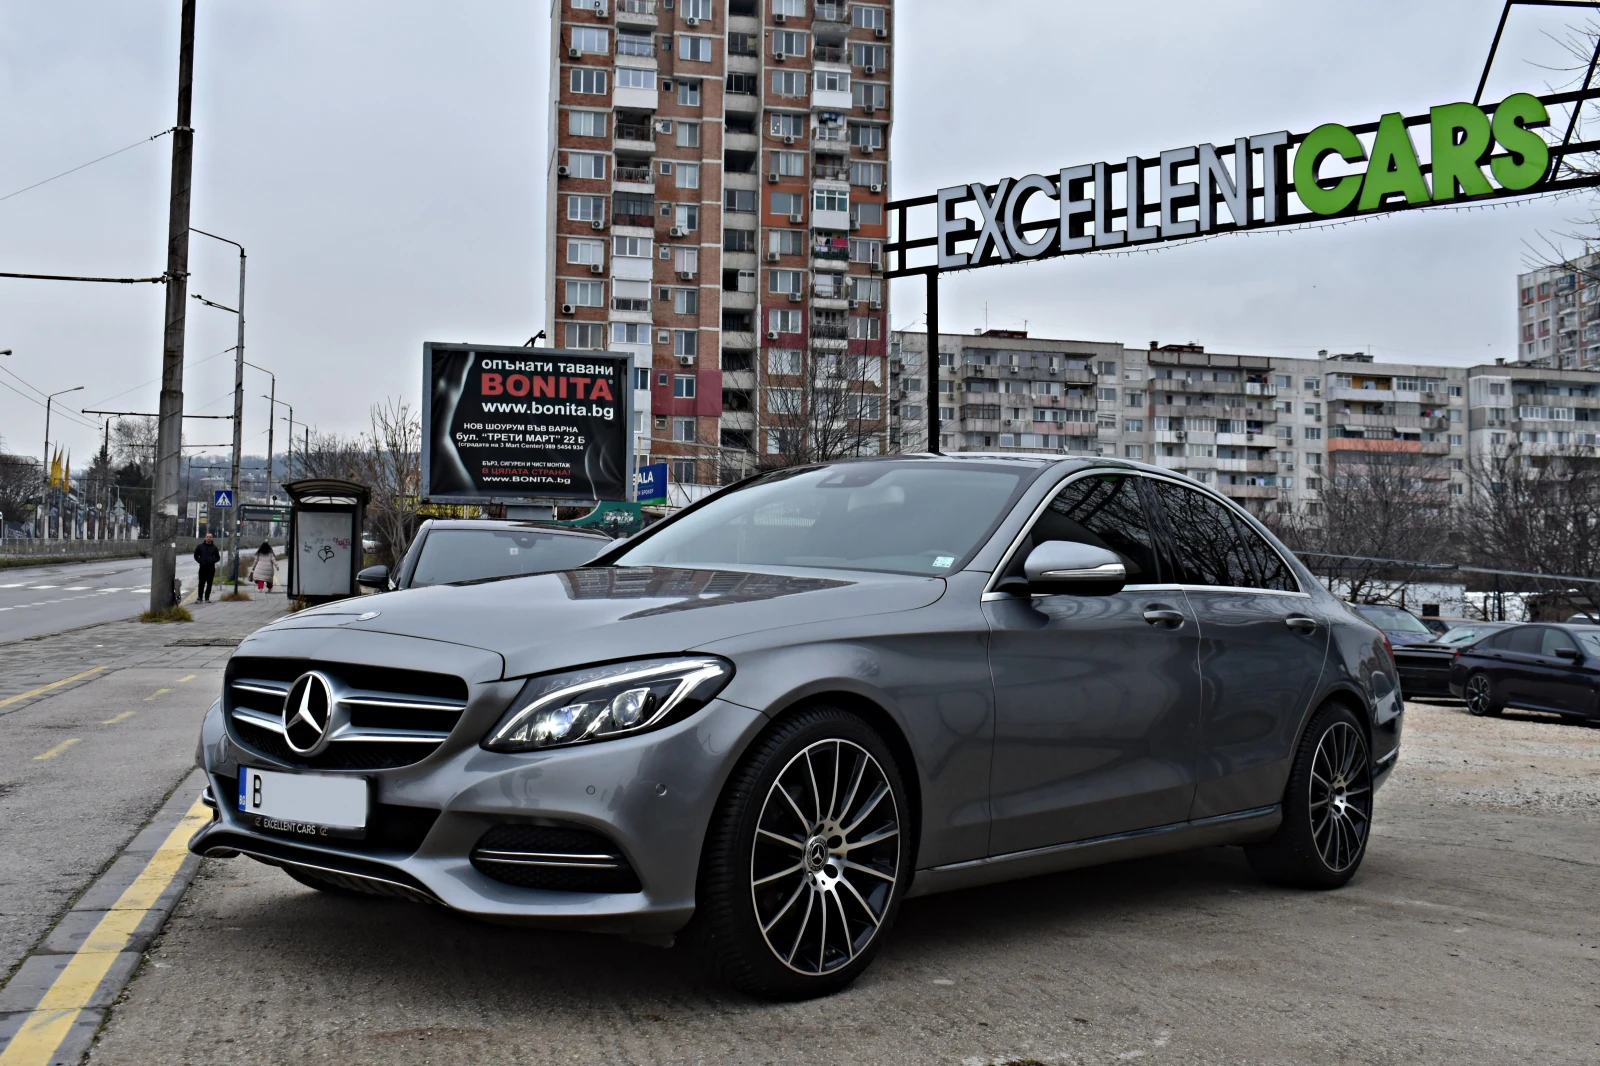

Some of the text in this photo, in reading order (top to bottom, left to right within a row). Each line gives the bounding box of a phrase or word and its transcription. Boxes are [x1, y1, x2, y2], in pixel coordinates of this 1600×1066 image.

[936, 92, 1550, 269] EXCELLENT CARS
[481, 359, 614, 376] опънати тавани
[481, 401, 614, 420] www.bonita.bg
[463, 422, 578, 433] НОВ ШОУРУМ ВЪВ ВАРНА
[456, 432, 479, 441] бул.
[563, 436, 575, 444] 22
[482, 476, 571, 485] www.BONITA.bg
[263, 818, 296, 832] EXCELLENT
[296, 823, 316, 835] CARS
